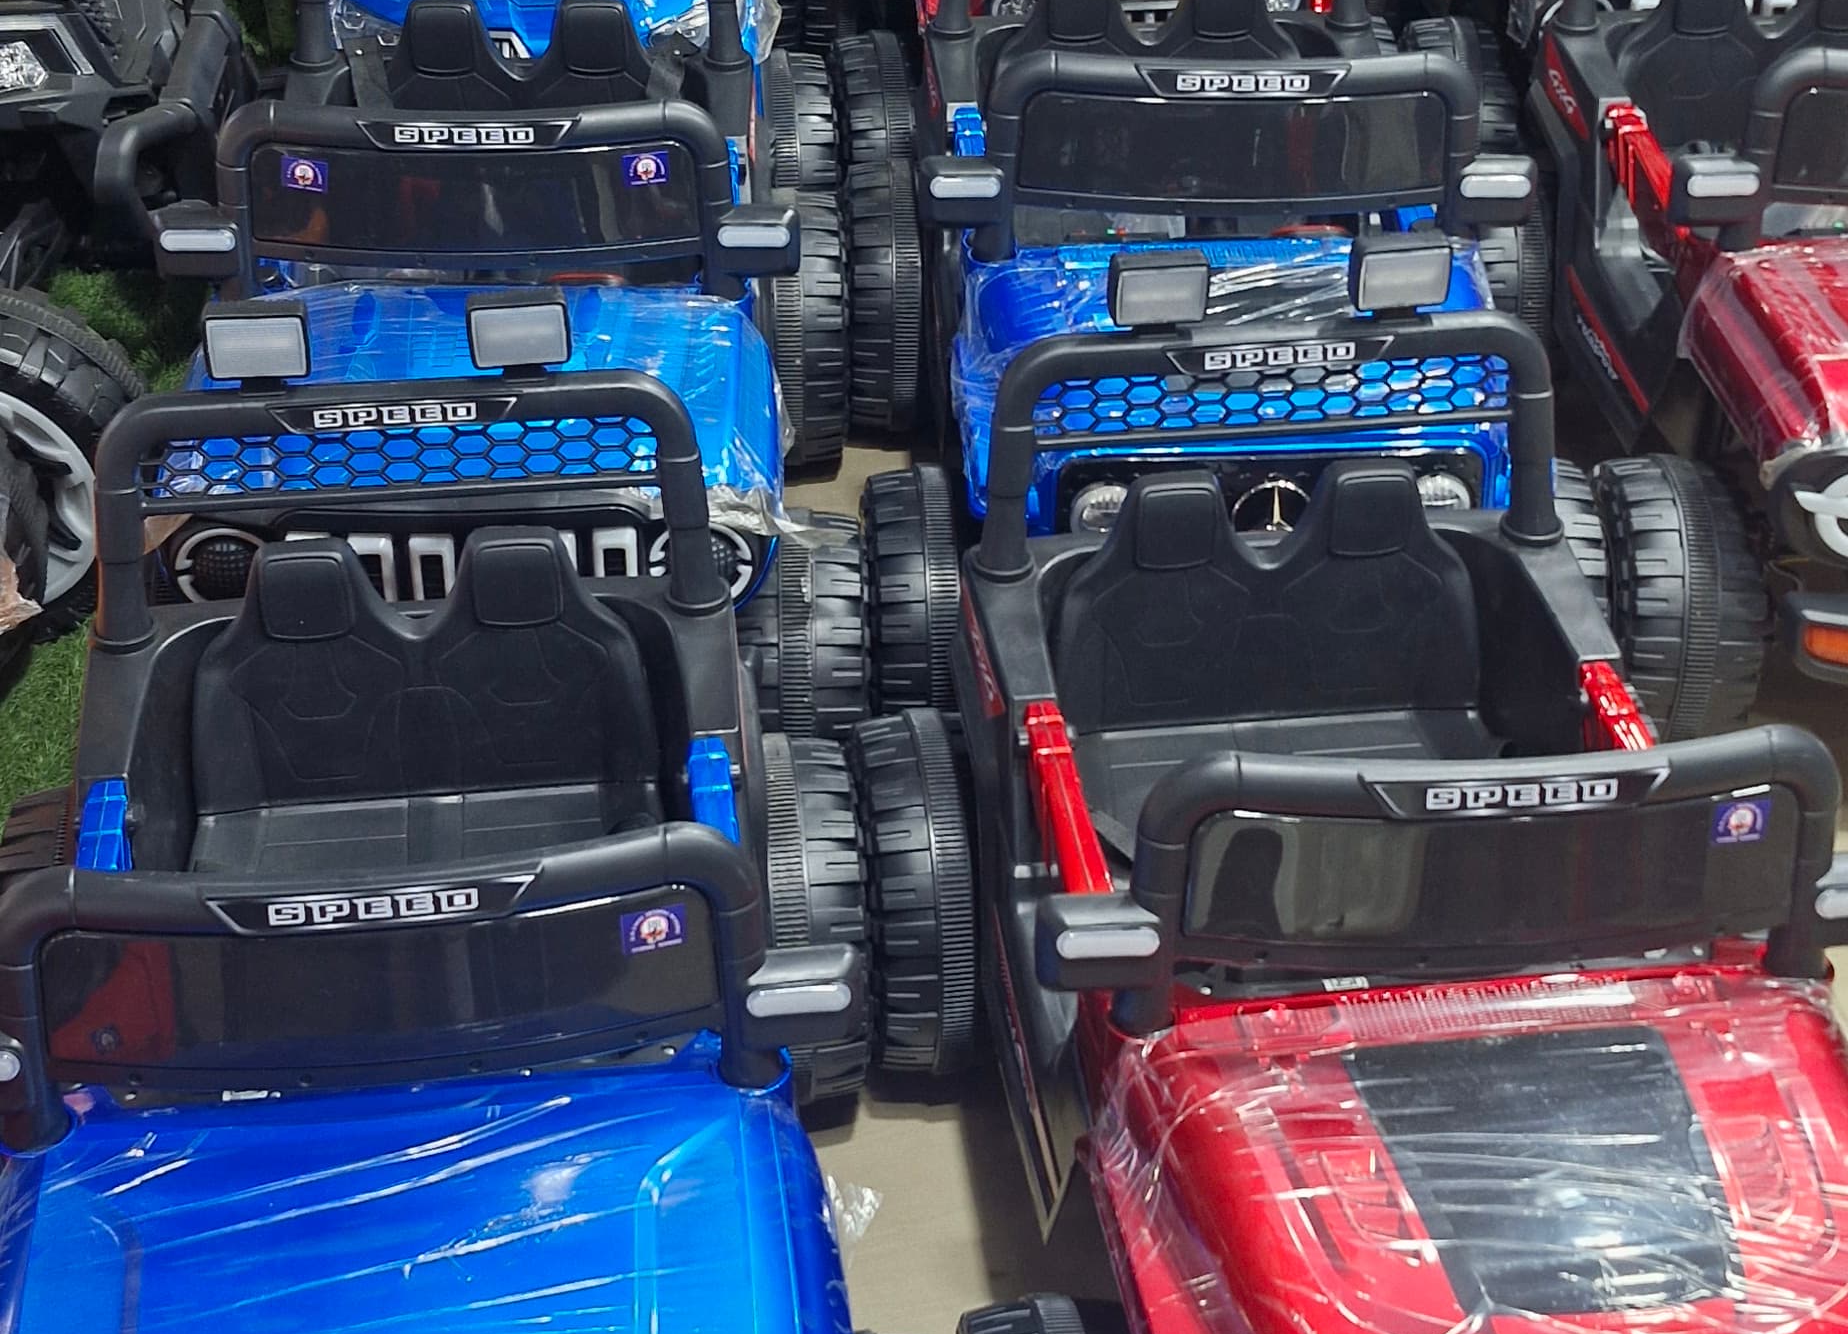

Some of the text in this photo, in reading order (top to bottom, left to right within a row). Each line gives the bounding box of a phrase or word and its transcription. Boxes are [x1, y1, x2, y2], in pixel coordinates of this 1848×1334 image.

[1176, 75, 1310, 91] SPEED
[394, 126, 535, 144] SPEED
[1204, 342, 1356, 371] SPEED
[313, 402, 477, 428] SPEED
[1426, 778, 1618, 811] SPEED
[267, 887, 479, 926] SPEED
